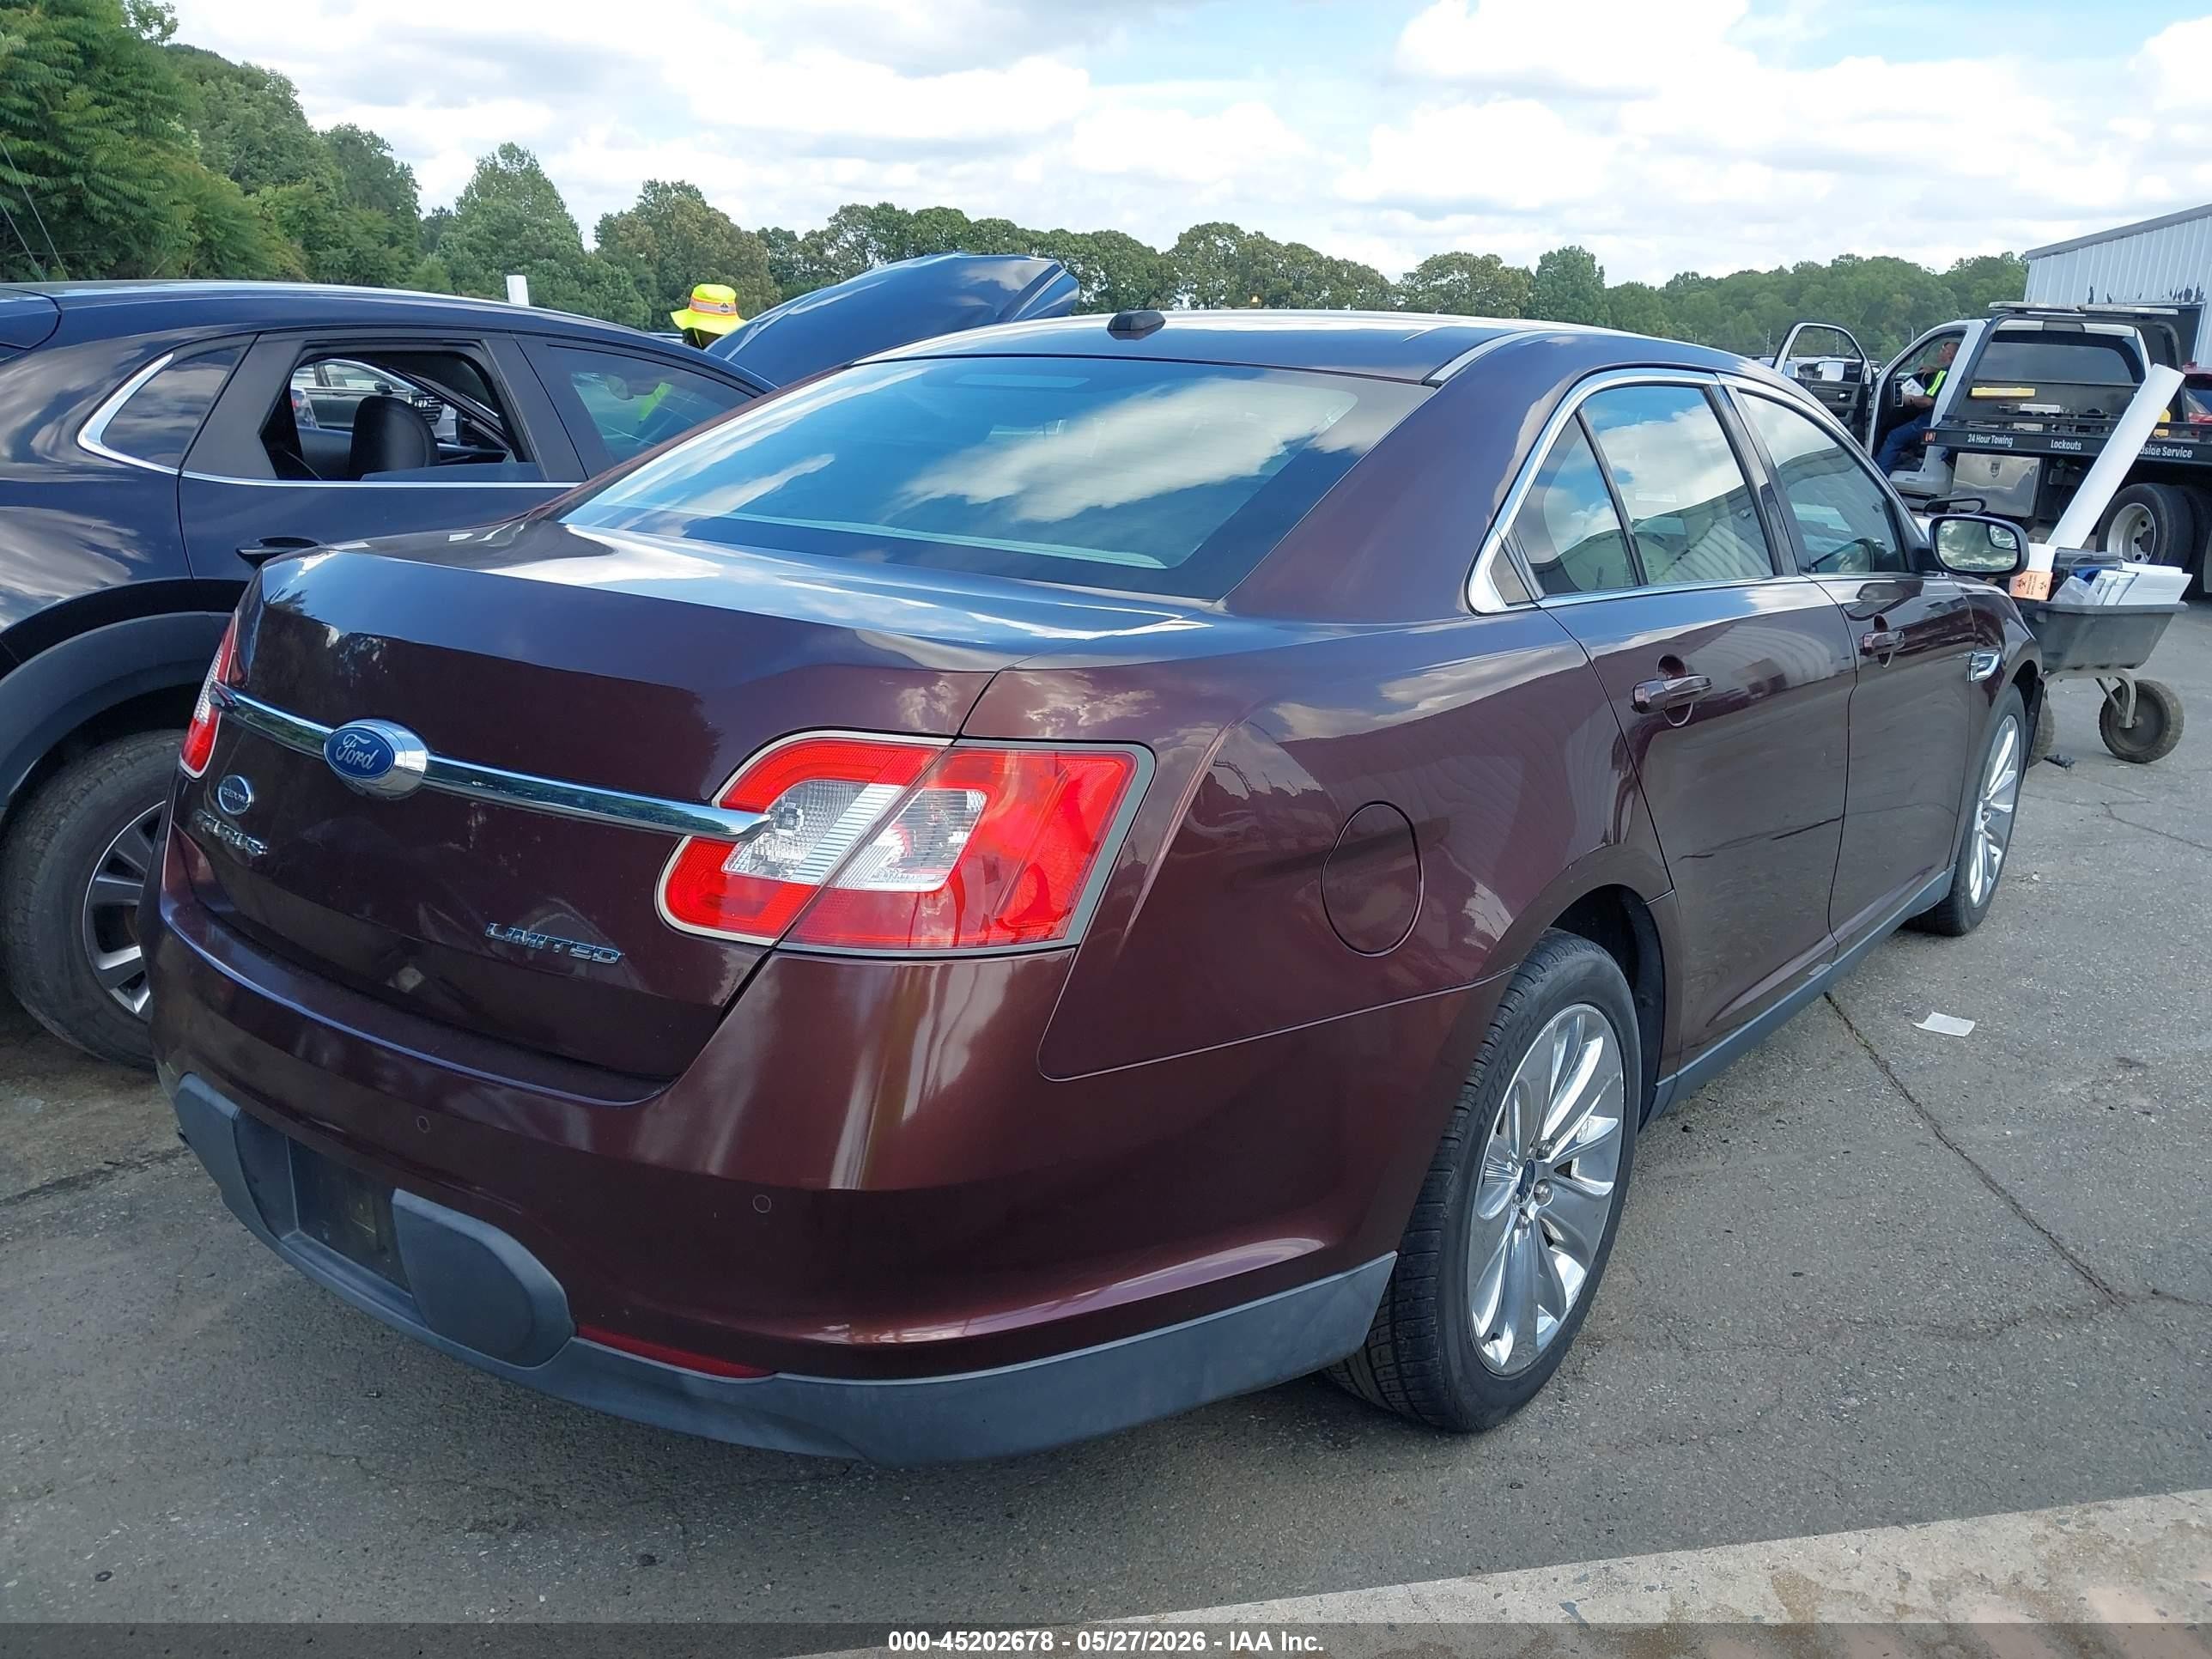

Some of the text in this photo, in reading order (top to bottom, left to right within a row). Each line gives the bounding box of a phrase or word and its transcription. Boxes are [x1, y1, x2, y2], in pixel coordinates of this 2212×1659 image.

[1967, 433, 2013, 447] 24 Hour Towing
[2051, 439, 2082, 451] Lockouts
[2162, 446, 2193, 459] Service
[335, 732, 380, 770] Ford
[484, 921, 621, 964] LIMITED
